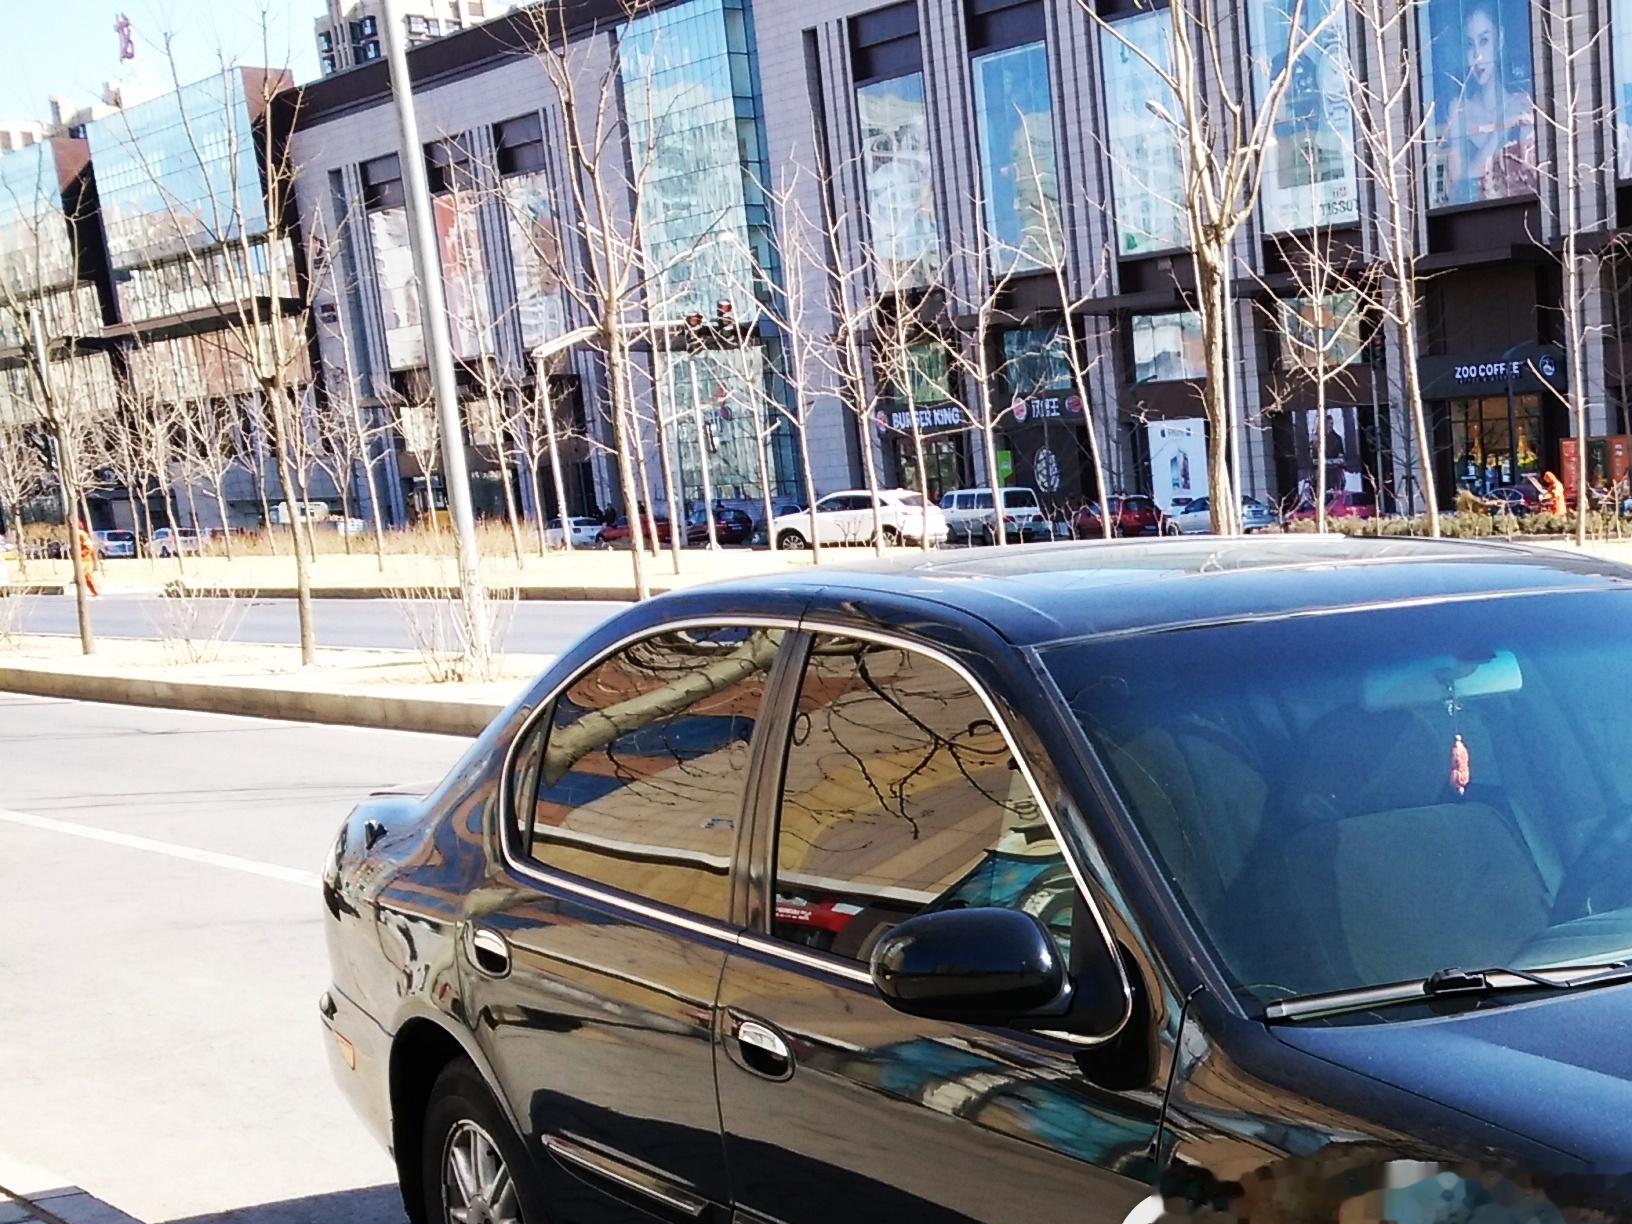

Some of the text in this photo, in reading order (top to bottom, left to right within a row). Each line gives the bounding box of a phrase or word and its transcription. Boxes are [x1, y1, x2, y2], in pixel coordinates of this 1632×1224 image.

[1454, 361, 1520, 379] ZOO COFFE
[933, 407, 960, 427] KING
